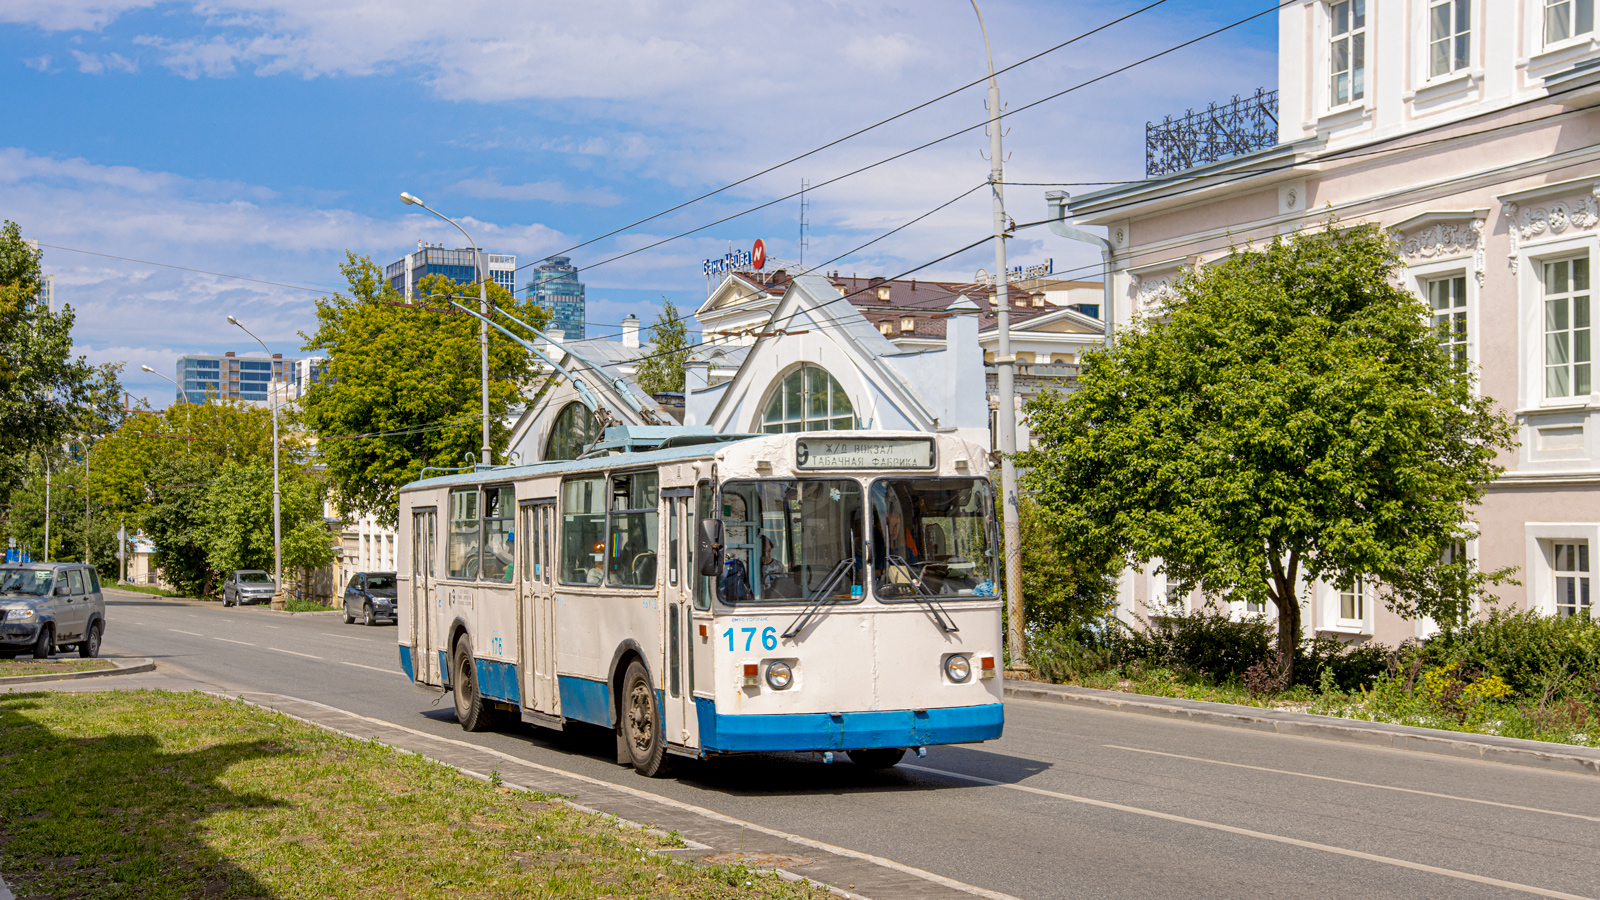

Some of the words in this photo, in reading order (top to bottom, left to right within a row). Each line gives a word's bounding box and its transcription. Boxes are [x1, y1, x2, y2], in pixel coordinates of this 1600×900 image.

[702, 258, 724, 276] Банк
[725, 249, 752, 268] Нейва
[825, 443, 847, 454] Ж/Д
[854, 444, 894, 454] ВОКЗАЛ
[812, 456, 864, 466] ТАБАЧНАЯ
[872, 457, 918, 467] ФАБРИКА
[492, 637, 502, 656] 176
[722, 626, 778, 652] 176
